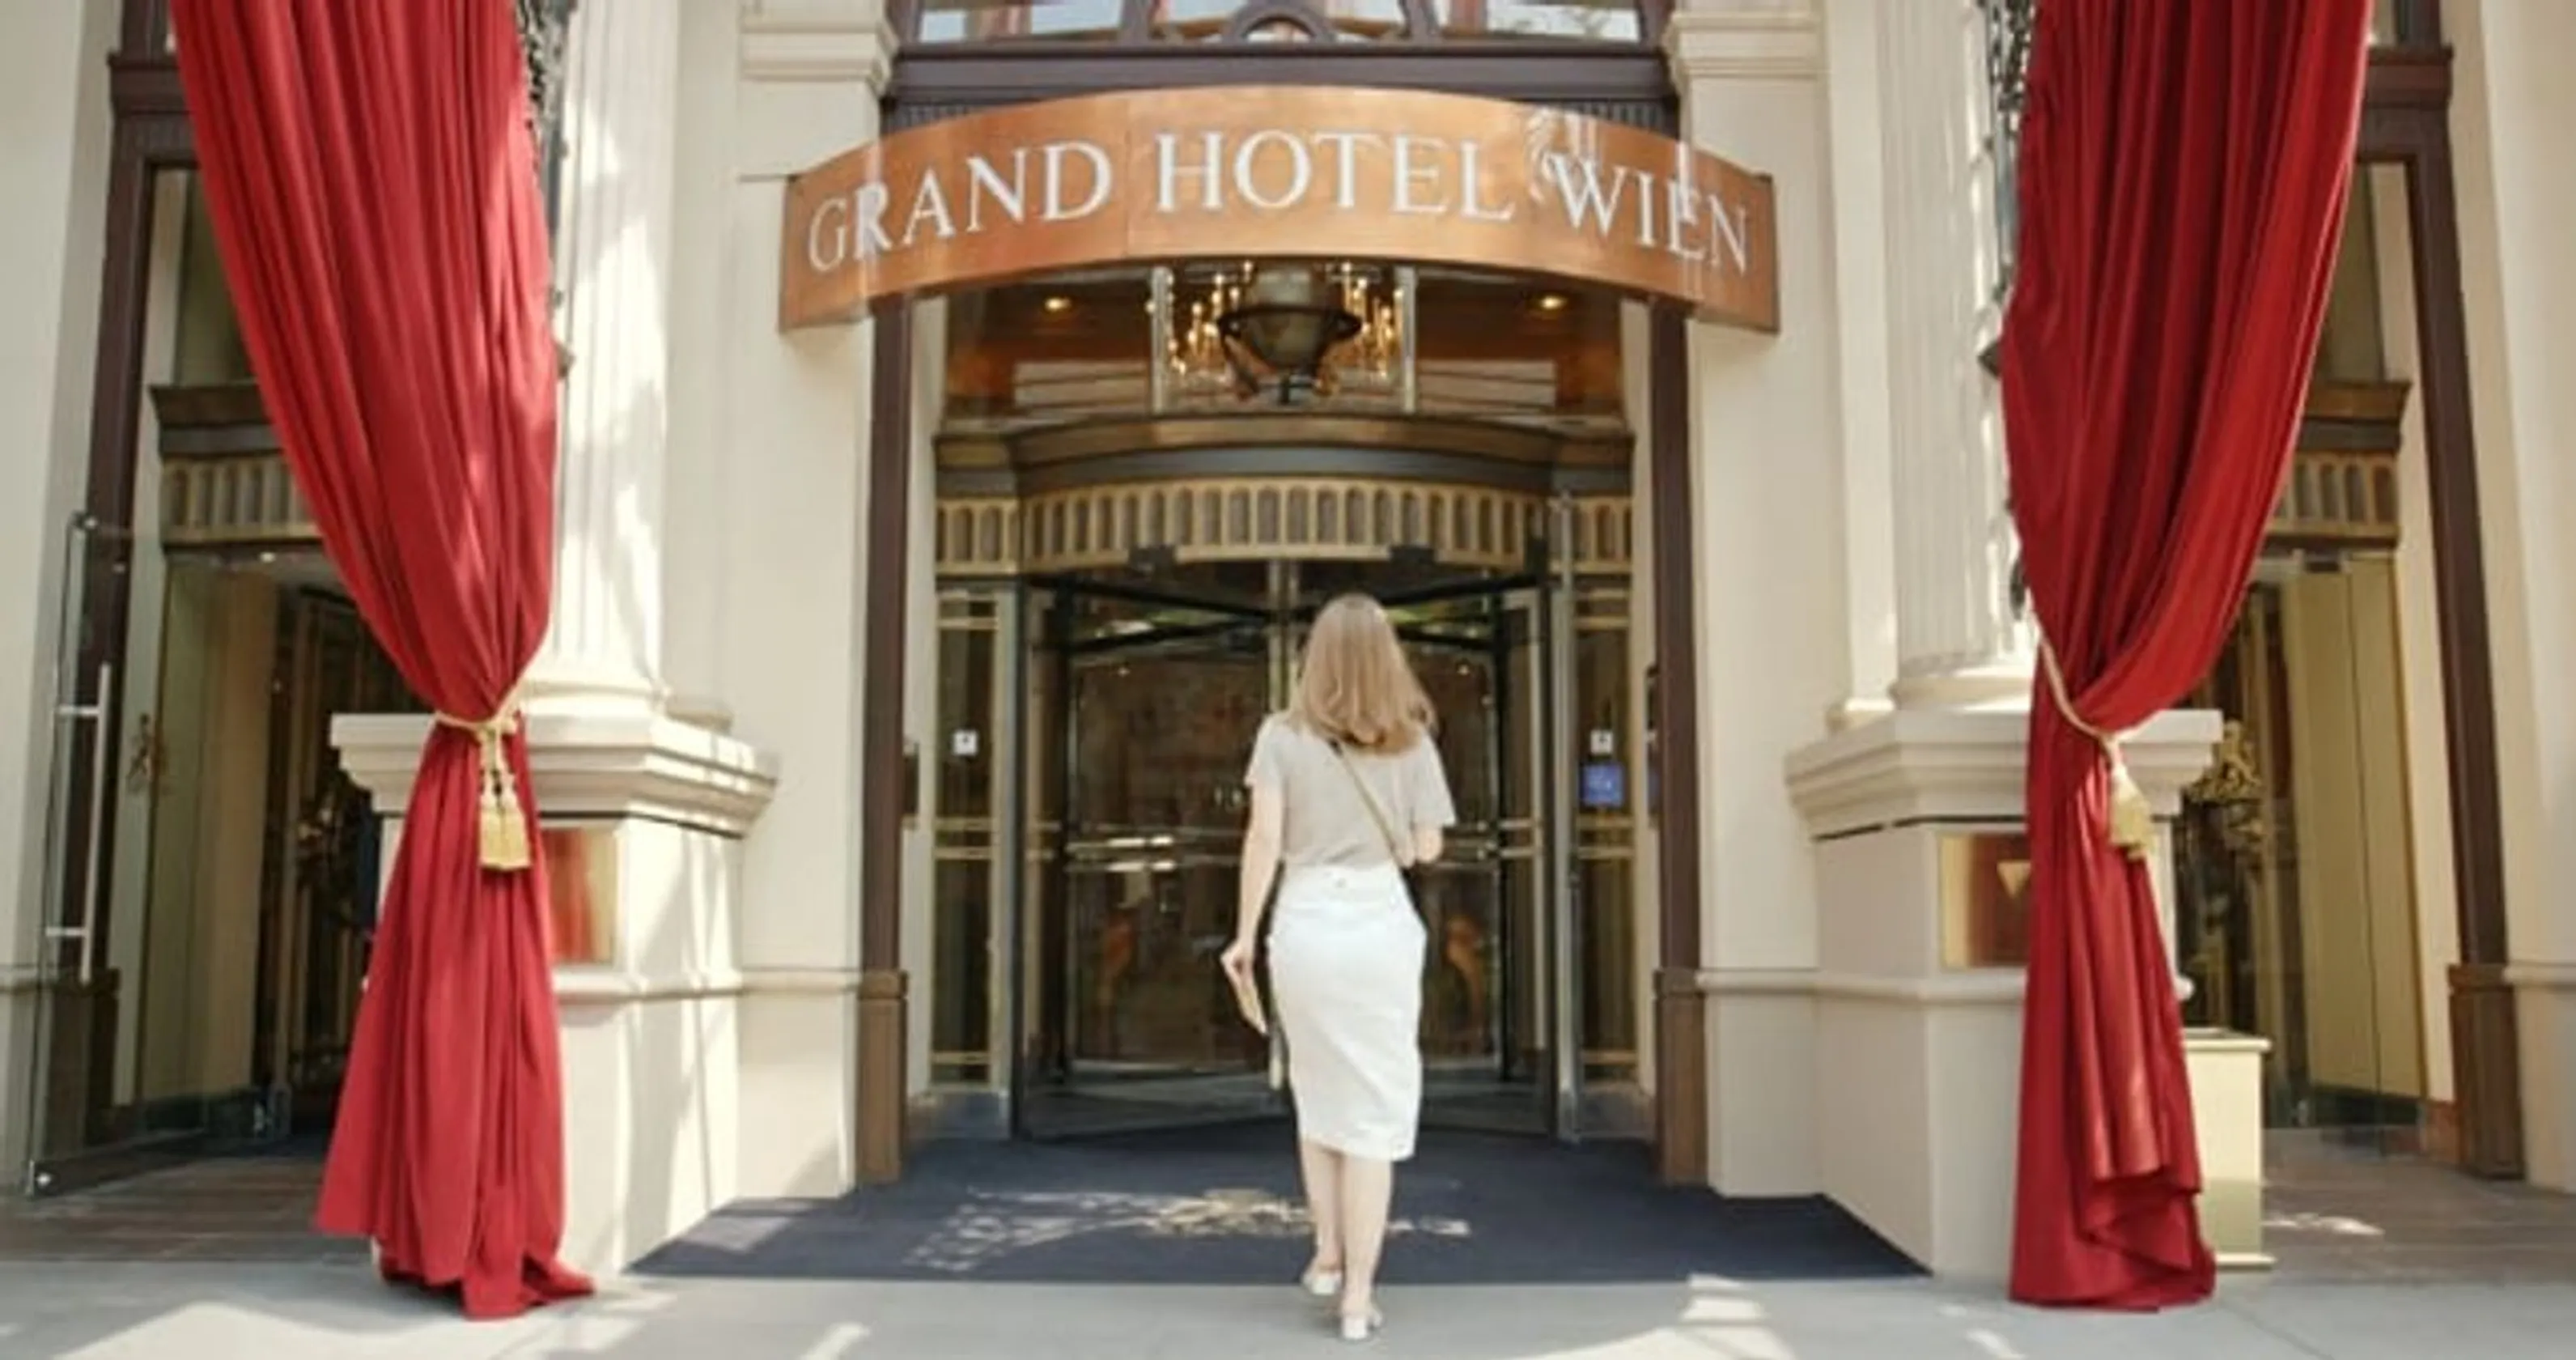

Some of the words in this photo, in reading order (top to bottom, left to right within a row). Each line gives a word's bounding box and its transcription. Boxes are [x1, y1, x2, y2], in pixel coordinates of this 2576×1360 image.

[809, 138, 1114, 272] GRAND
[1155, 129, 1516, 222] HOTEL
[1547, 151, 1749, 276] WIEN
